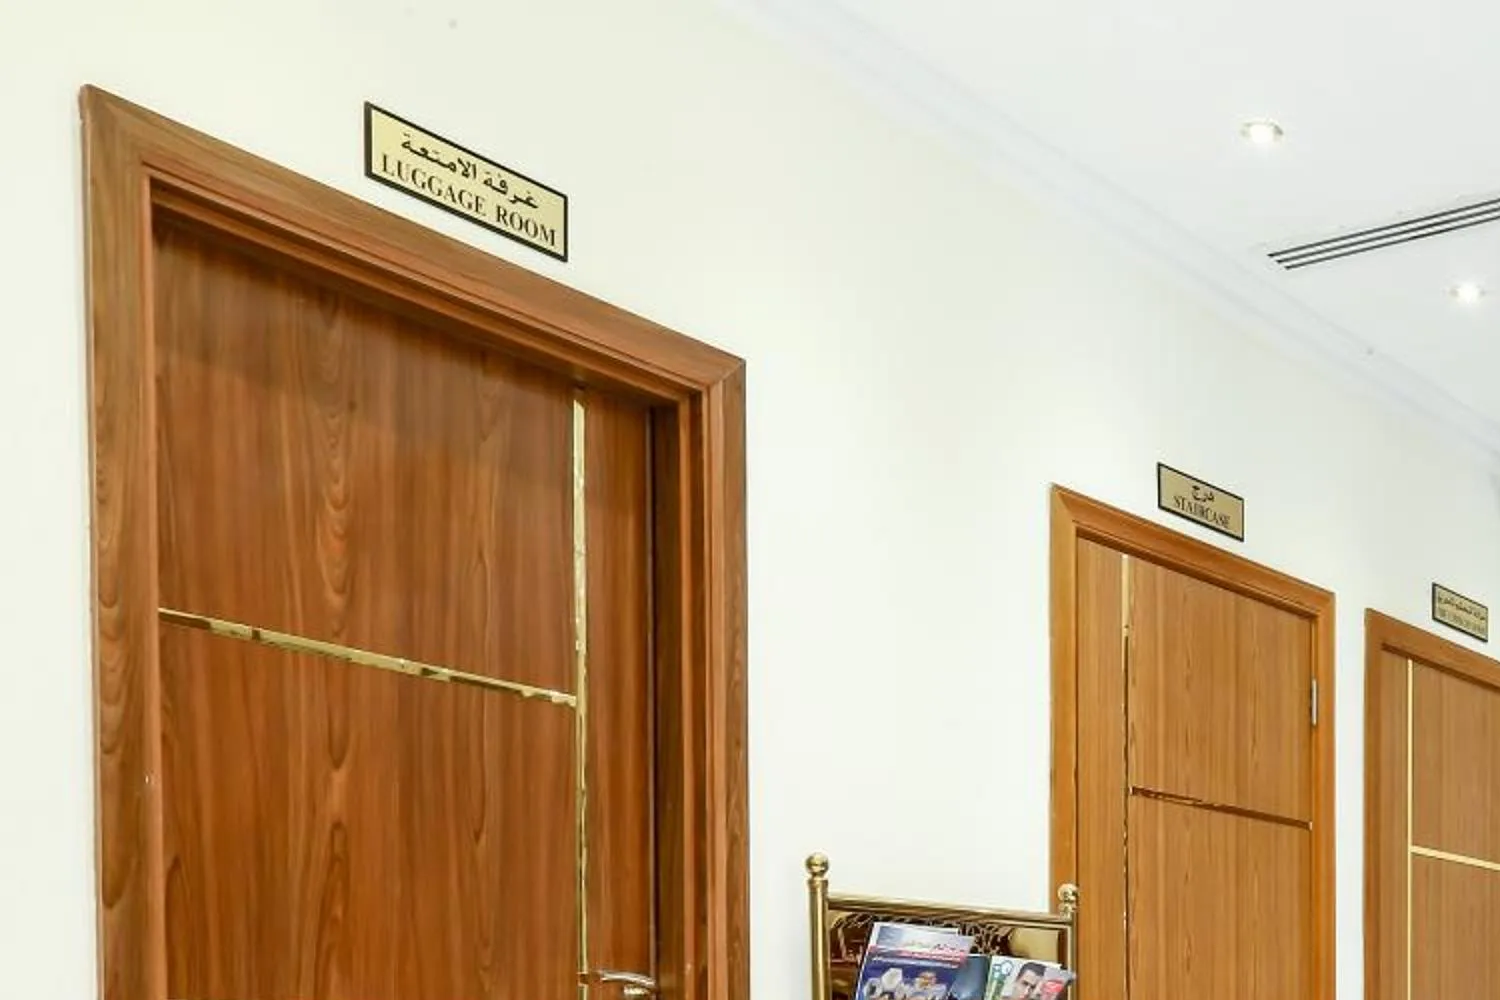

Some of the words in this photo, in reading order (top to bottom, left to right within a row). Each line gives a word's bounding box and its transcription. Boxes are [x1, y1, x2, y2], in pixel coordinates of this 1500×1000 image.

[381, 152, 486, 217] LUGGAGE
[495, 204, 557, 247] ROOM
[483, 171, 539, 209] غرفة
[1173, 495, 1231, 529] STAIRCASE
